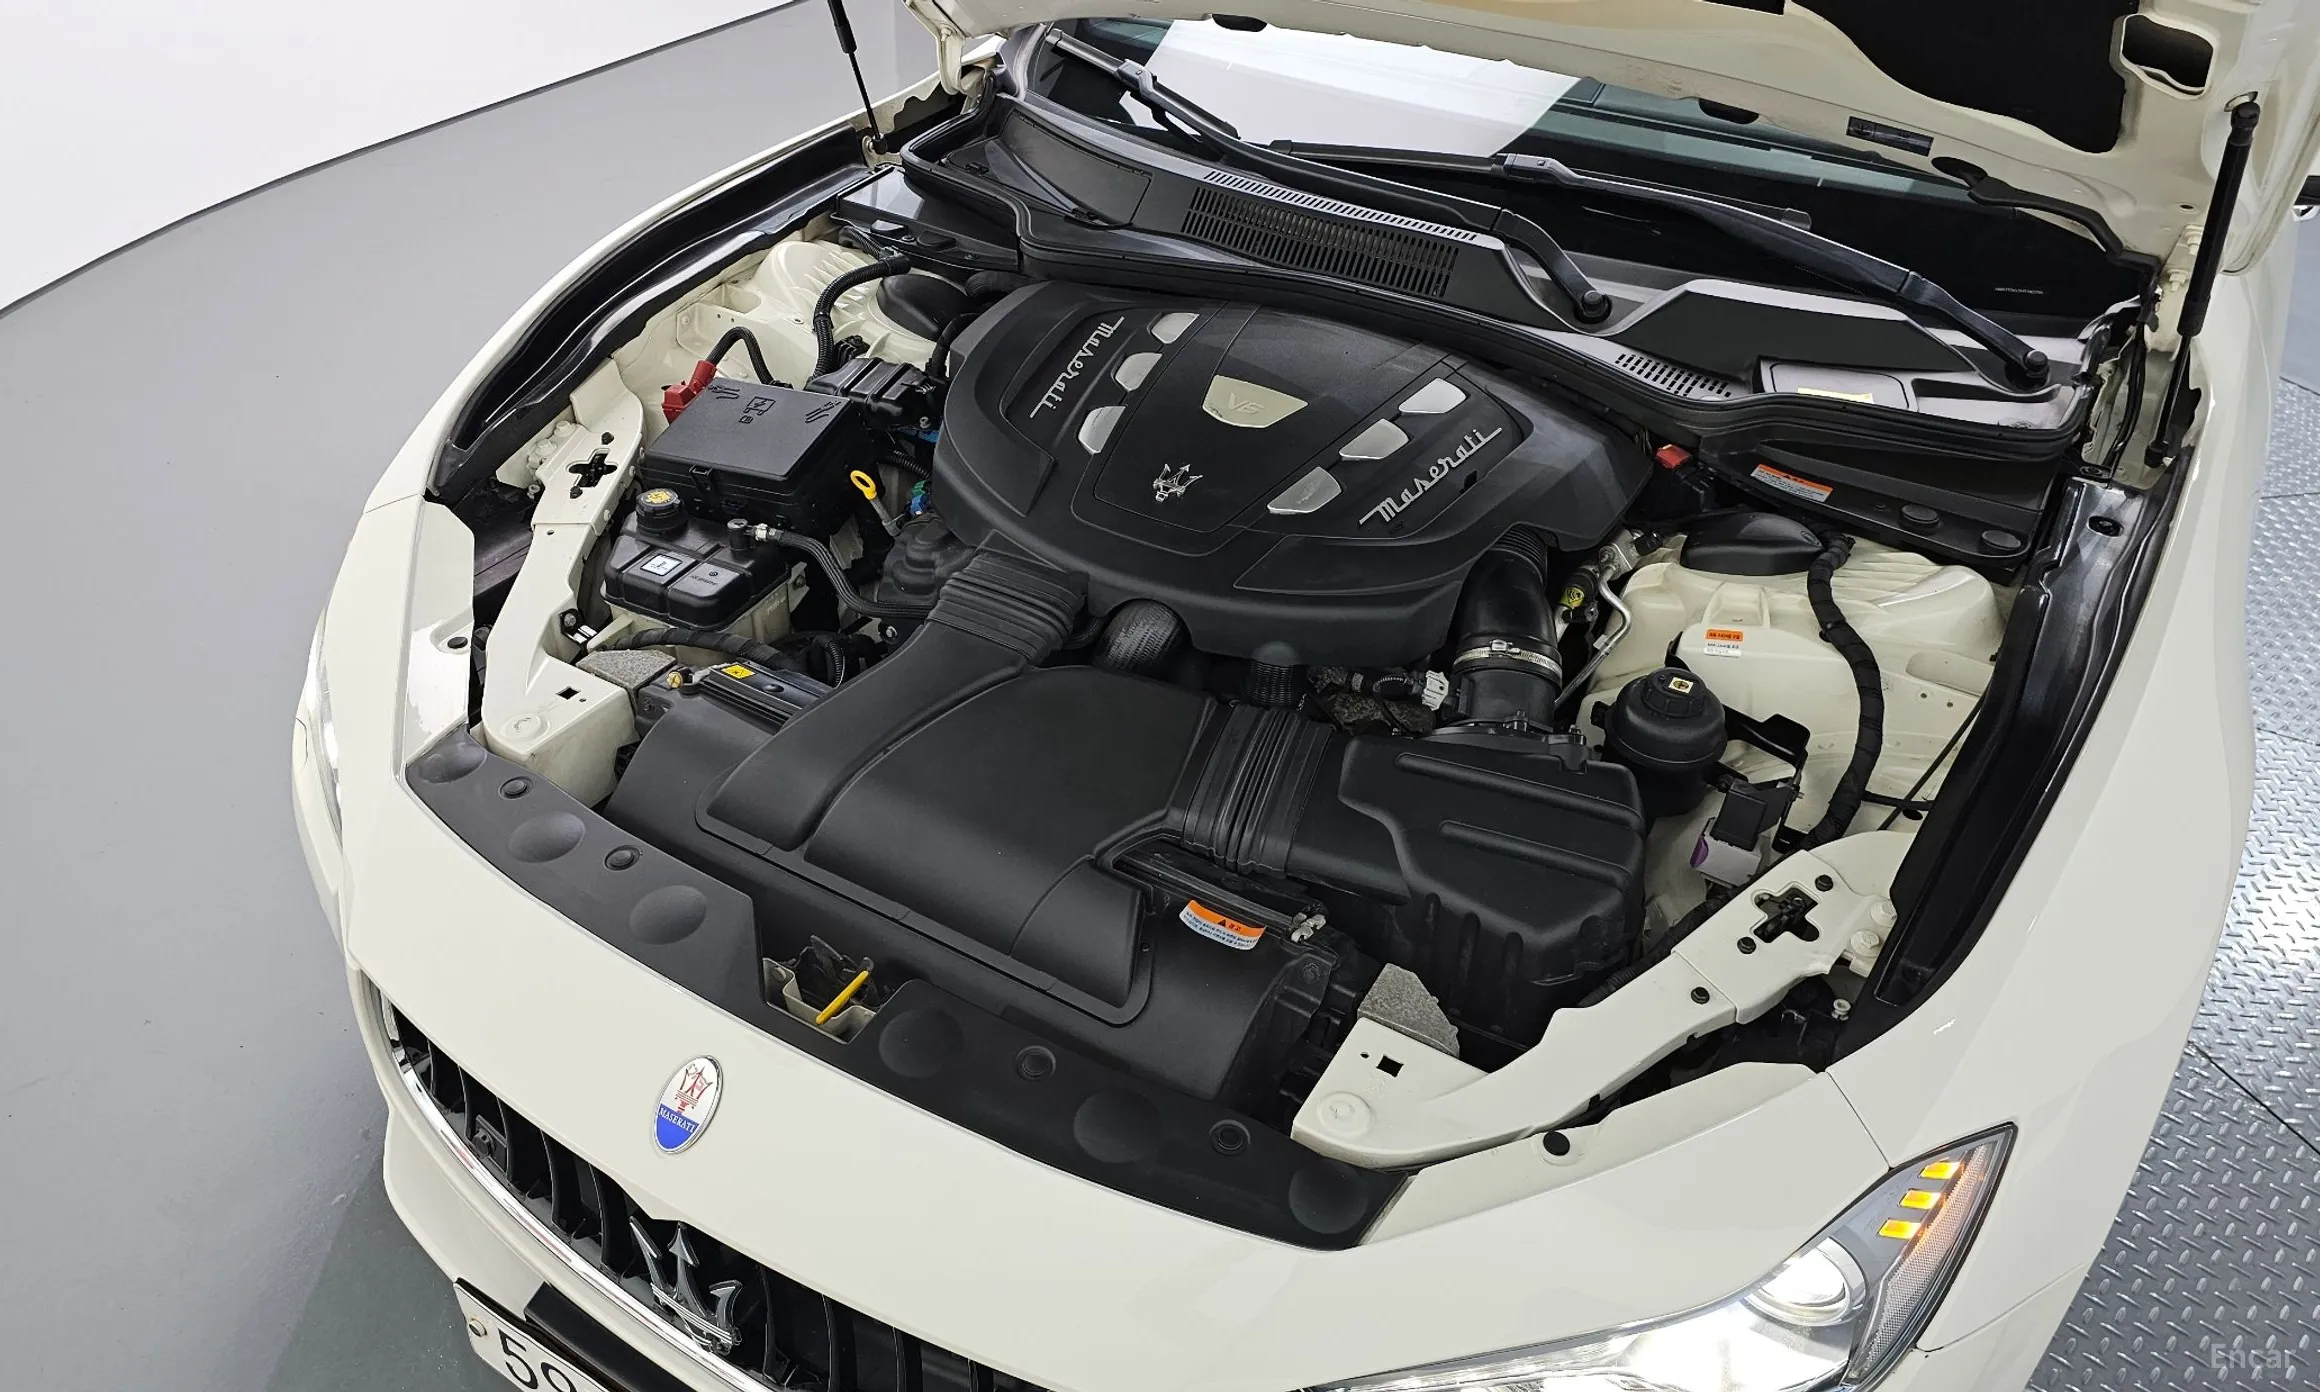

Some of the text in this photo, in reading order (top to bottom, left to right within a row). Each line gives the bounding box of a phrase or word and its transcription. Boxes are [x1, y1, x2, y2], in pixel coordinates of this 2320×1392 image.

[1030, 316, 1125, 418] Maserati
[1358, 427, 1503, 525] Maserati
[659, 1107, 696, 1133] MASERATI
